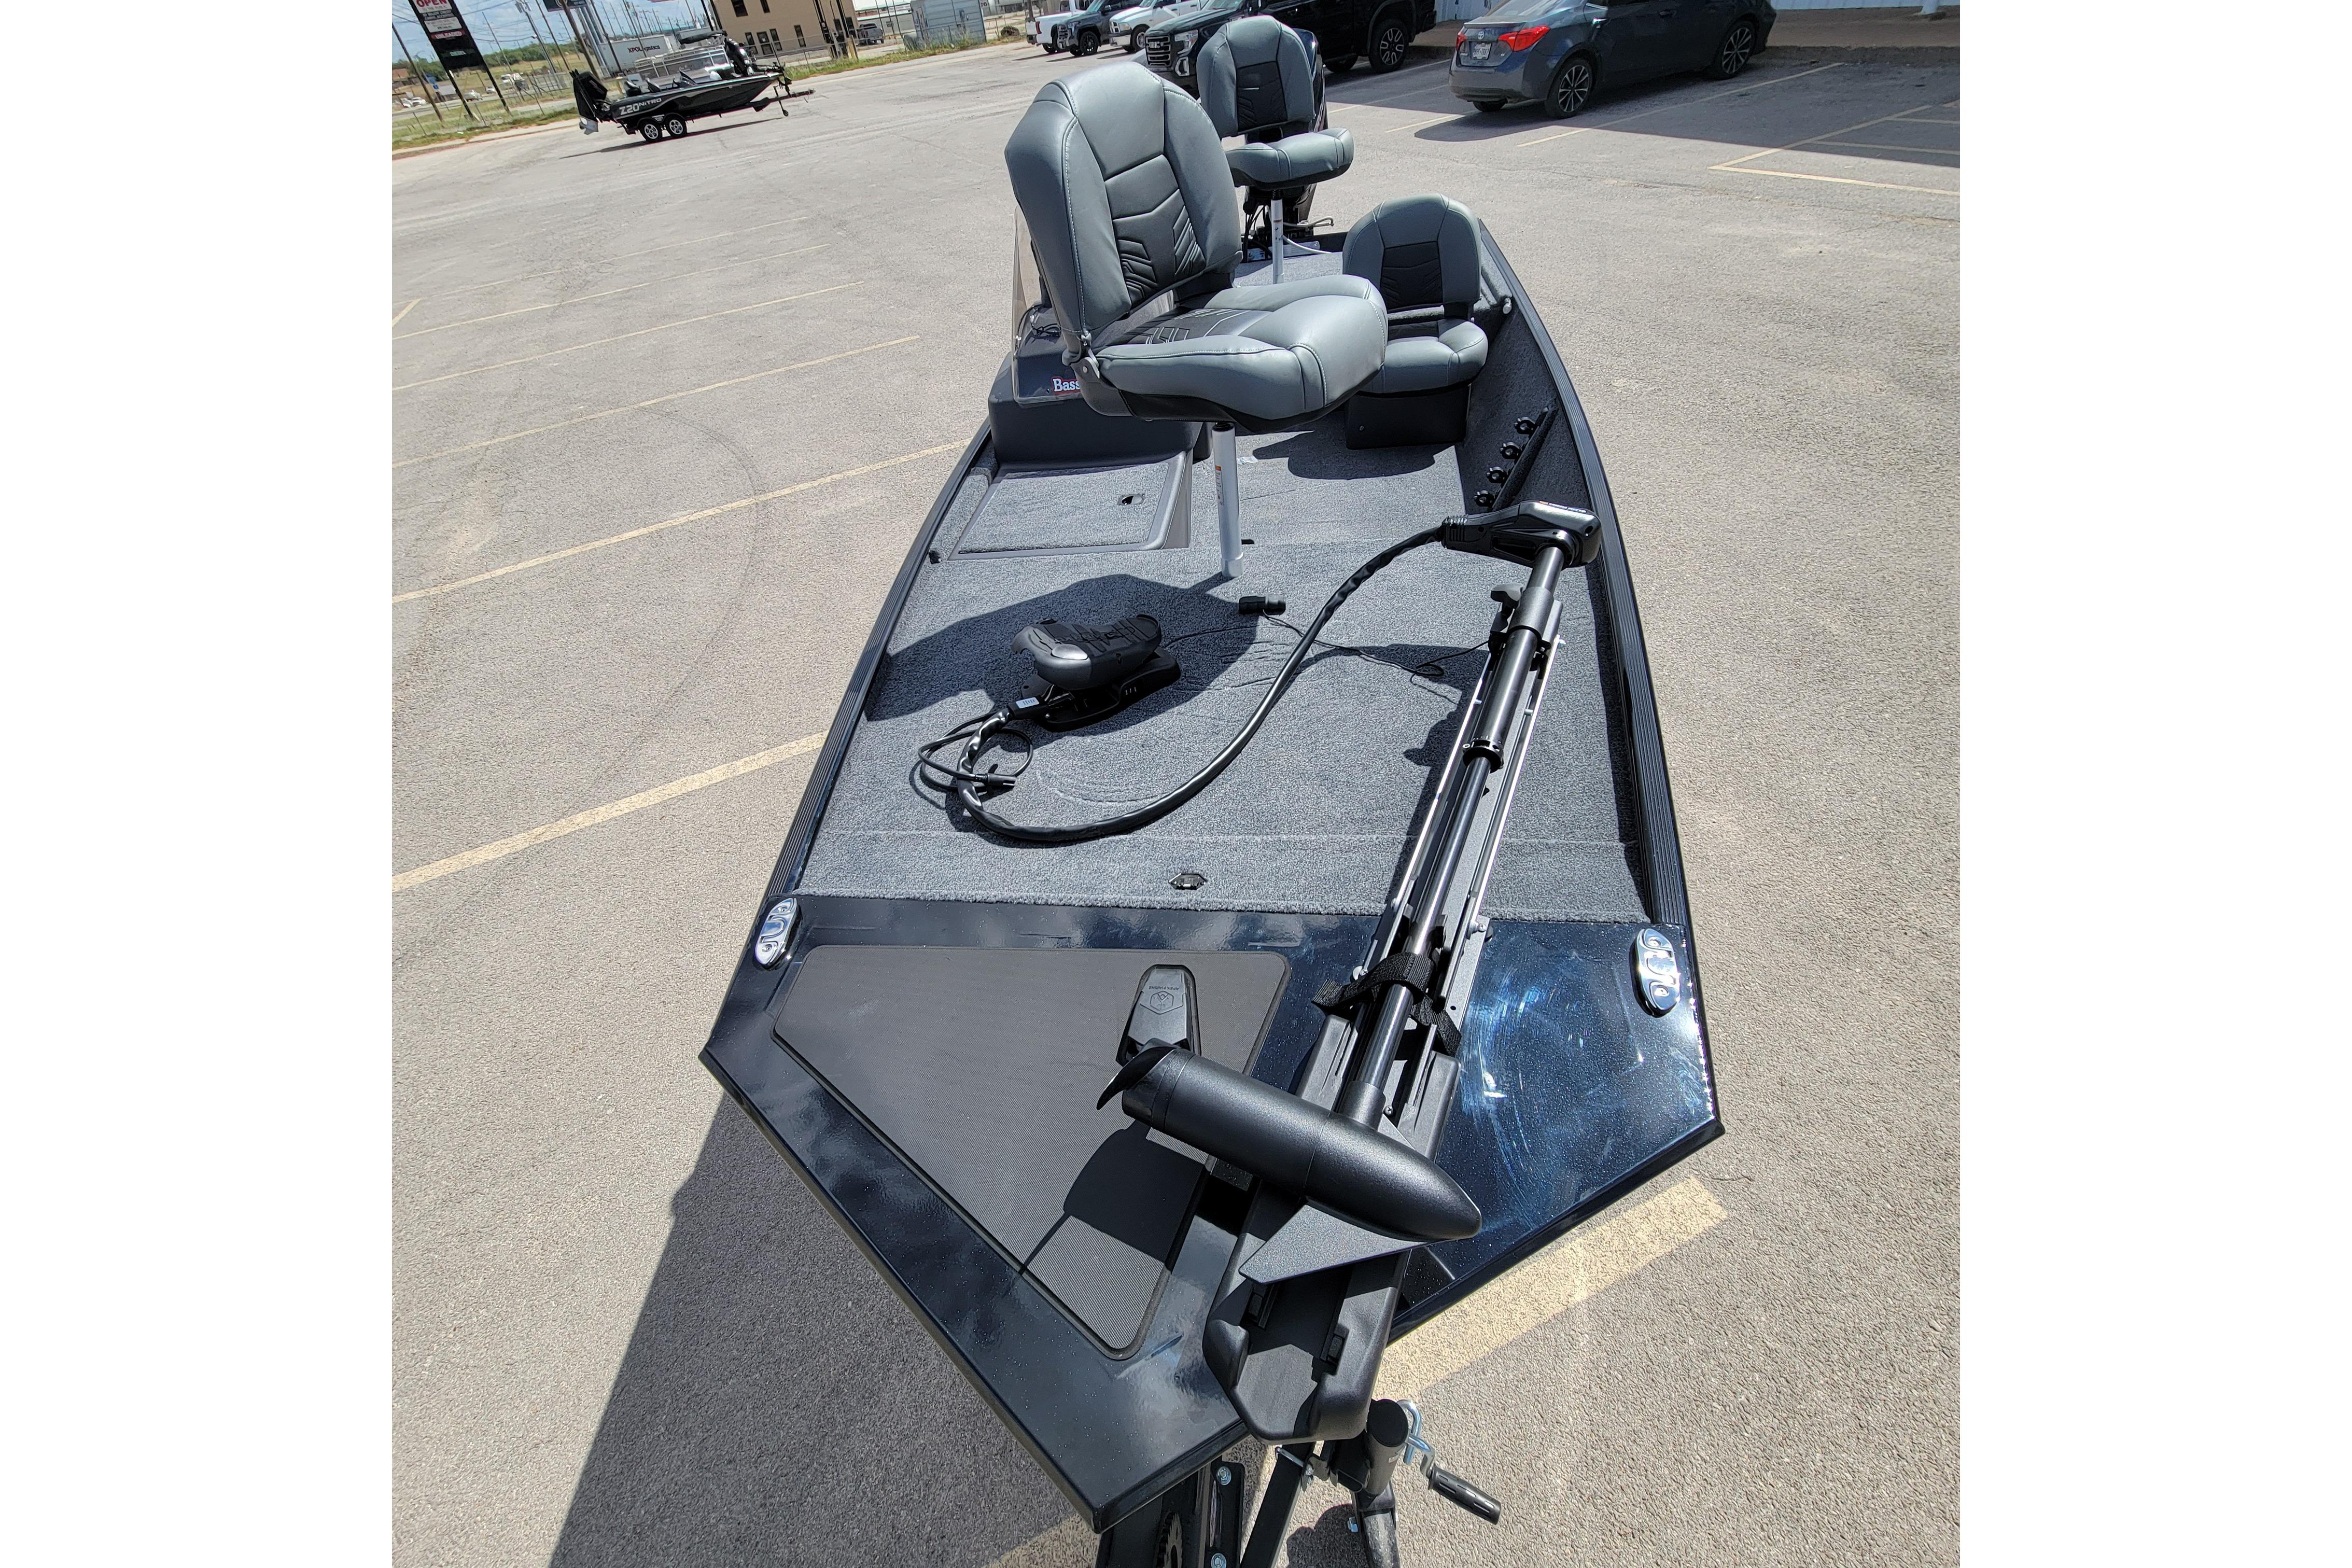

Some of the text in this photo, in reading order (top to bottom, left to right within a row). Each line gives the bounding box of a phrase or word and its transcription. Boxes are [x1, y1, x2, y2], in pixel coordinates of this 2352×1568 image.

[619, 97, 662, 115] Z20 NITRO
[1053, 378, 1081, 392] Bass
